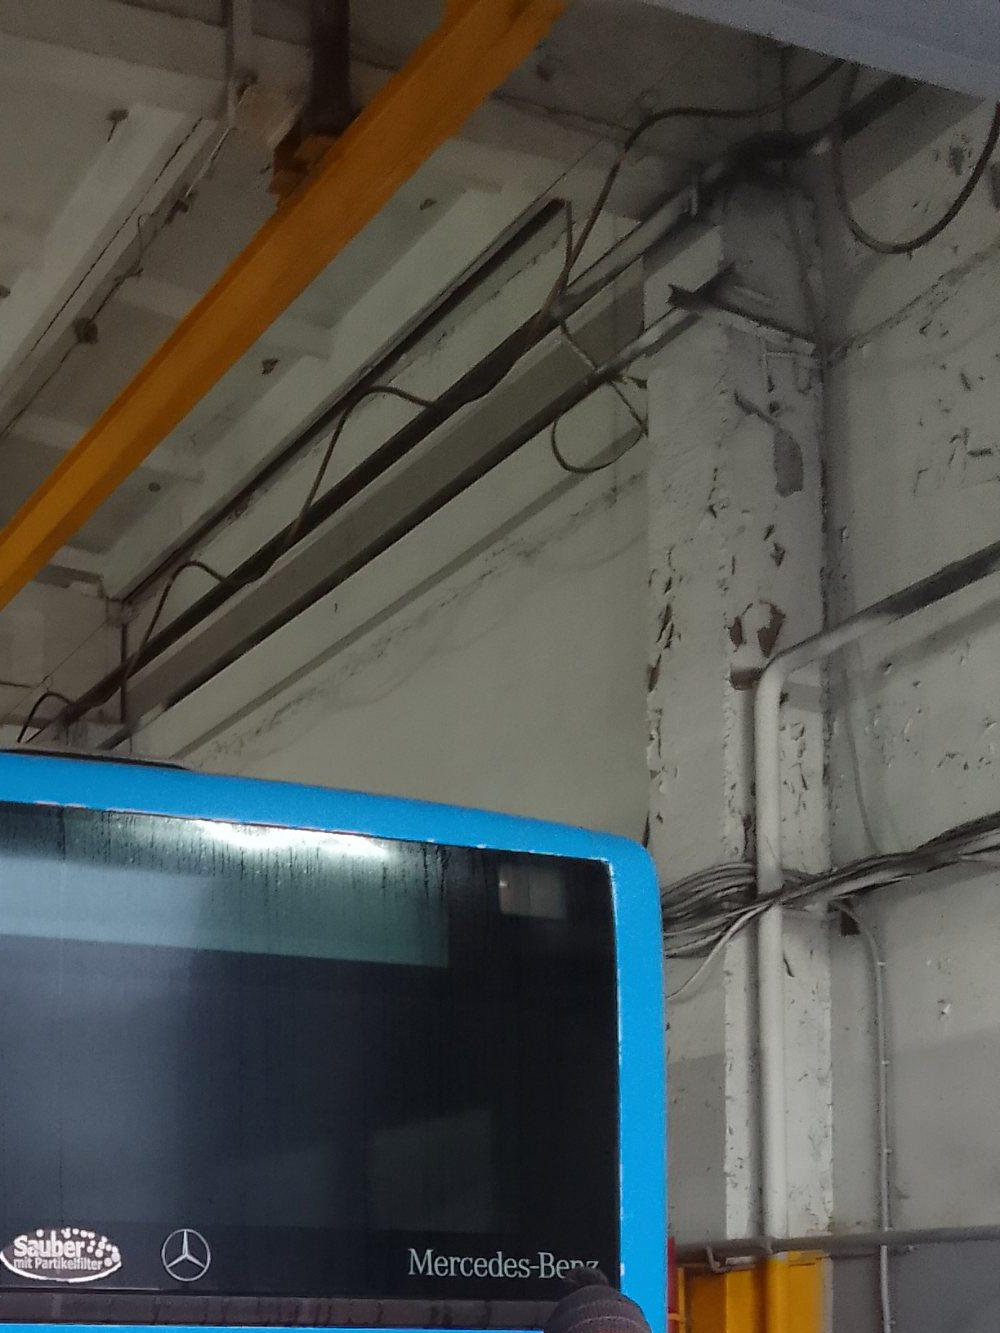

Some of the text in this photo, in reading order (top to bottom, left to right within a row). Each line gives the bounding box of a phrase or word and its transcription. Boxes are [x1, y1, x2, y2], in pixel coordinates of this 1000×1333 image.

[13, 1230, 85, 1258] Sauber
[13, 1256, 103, 1271] mit Partikelfilter
